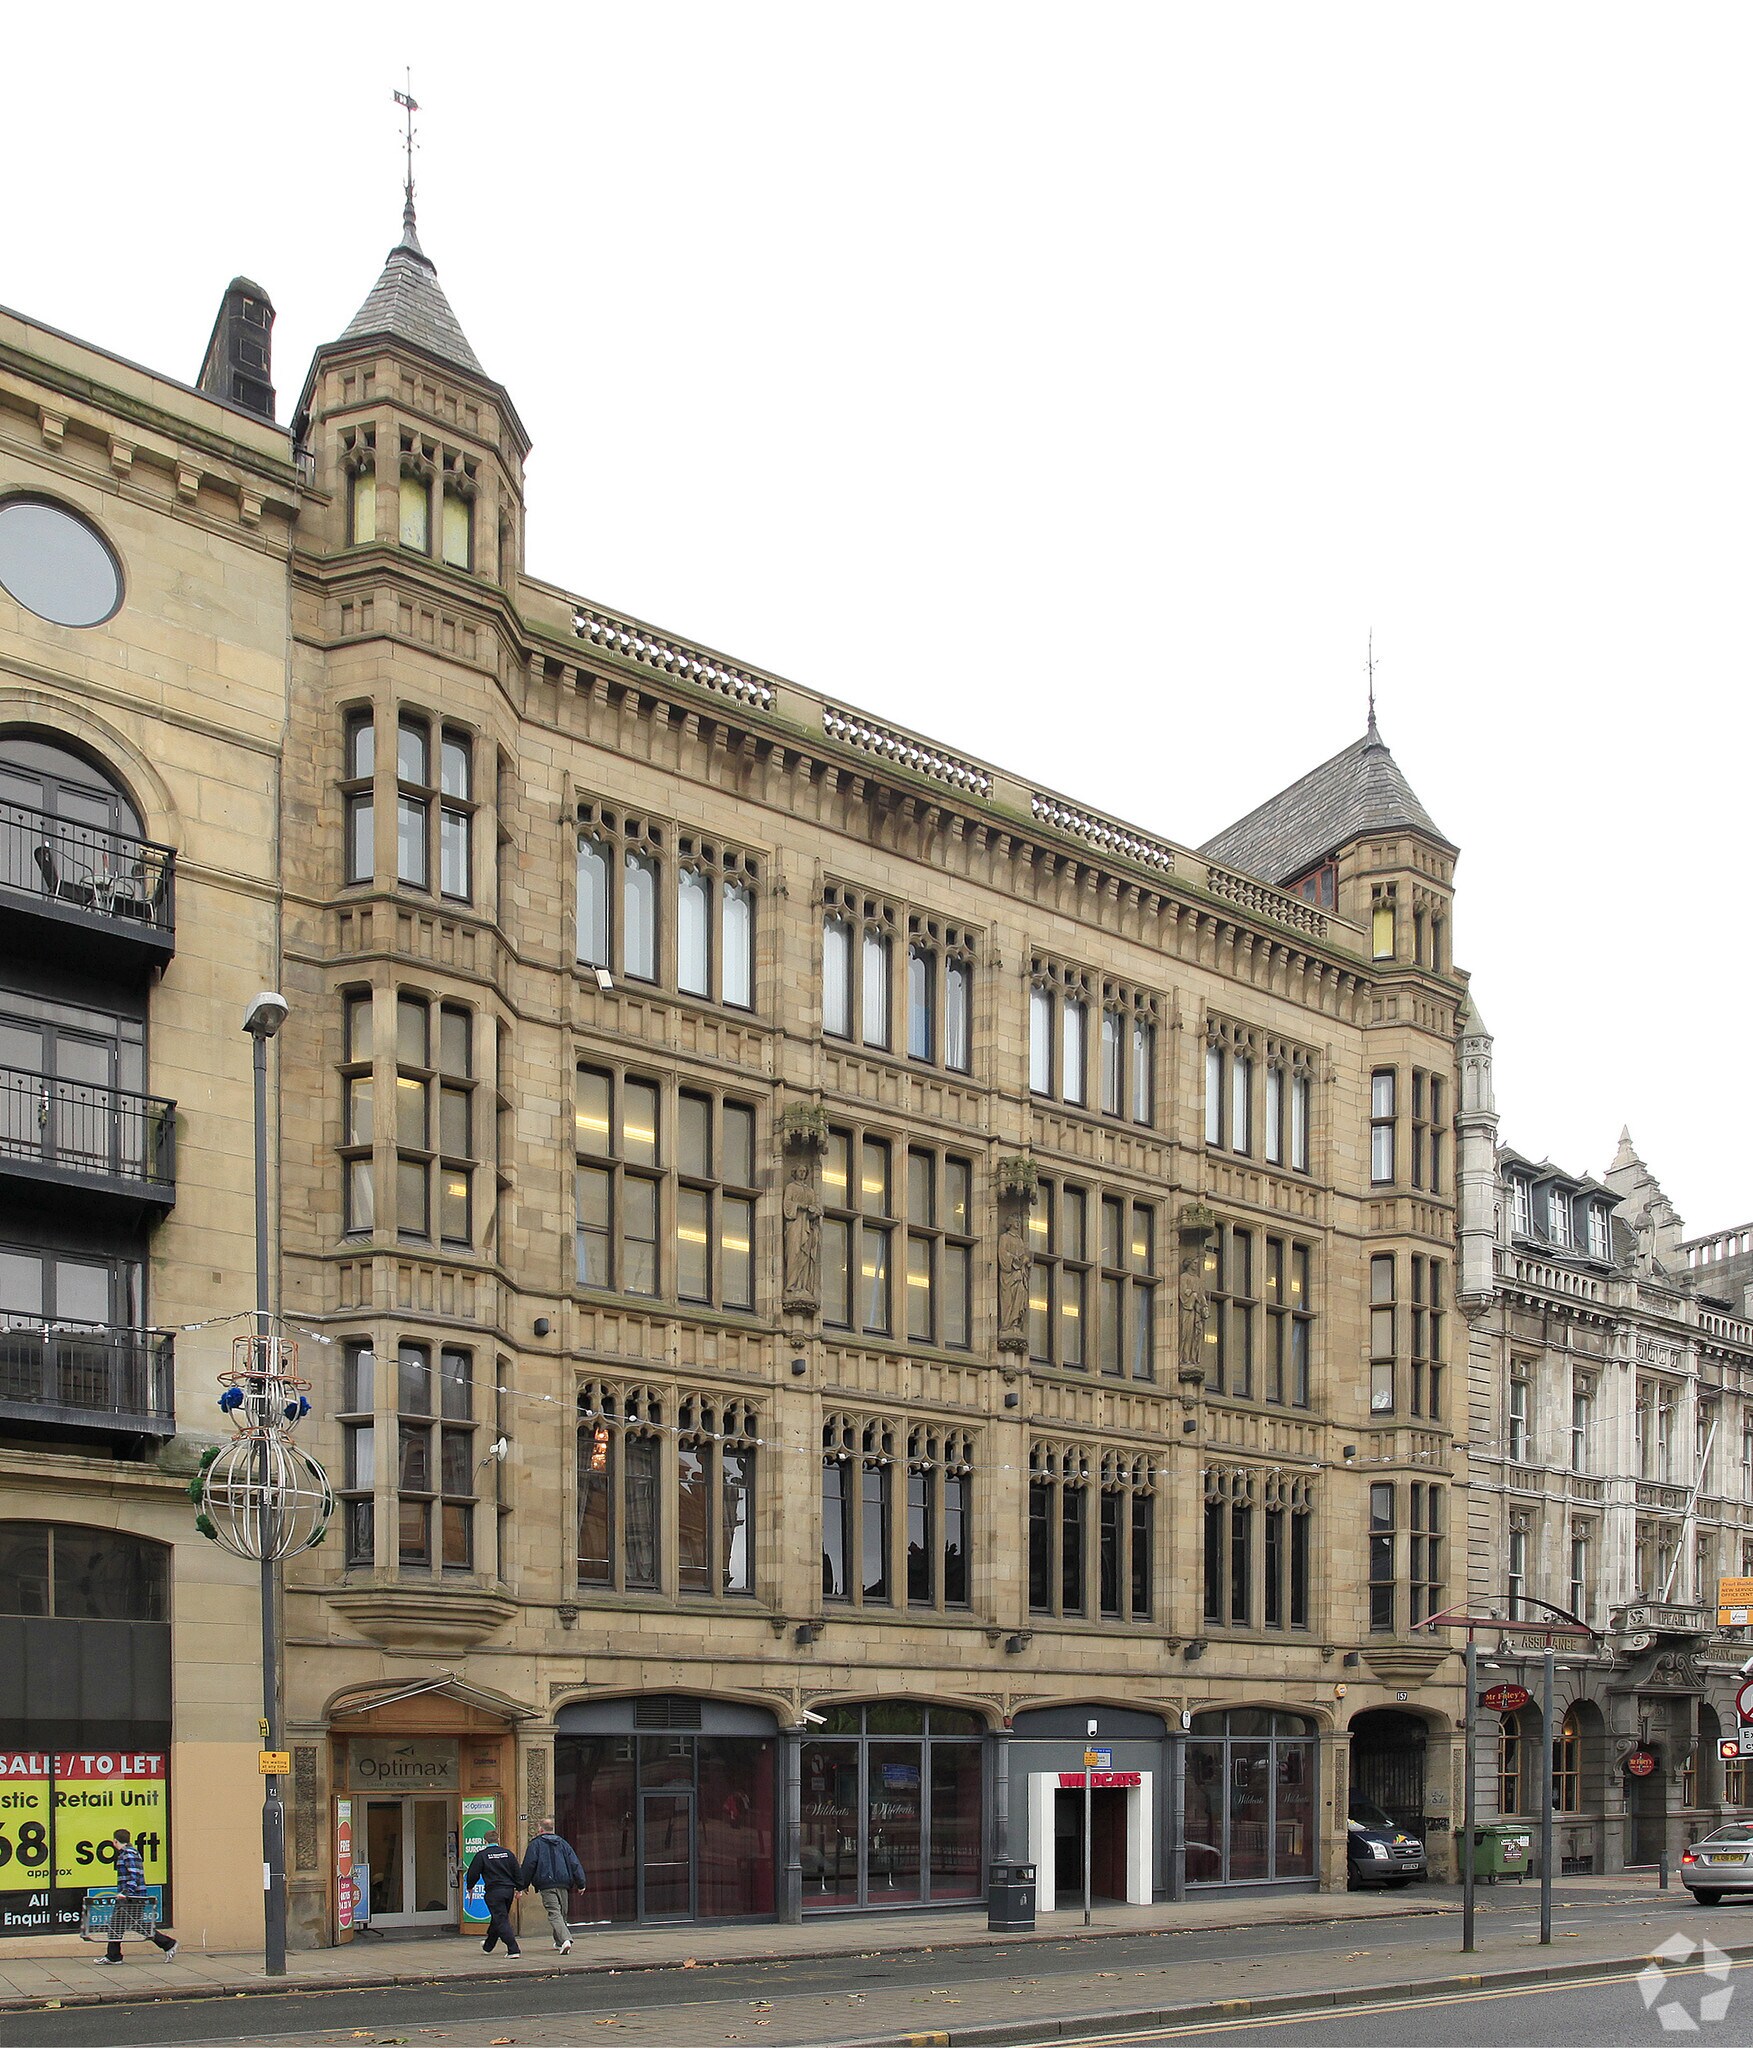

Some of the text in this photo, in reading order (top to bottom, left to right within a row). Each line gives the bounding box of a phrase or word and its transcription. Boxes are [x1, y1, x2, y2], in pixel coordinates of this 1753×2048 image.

[1521, 1636, 1577, 1651] ASSUANCE
[1397, 1692, 1408, 1701] 157
[1745, 1743, 1753, 1751] c
[80, 1755, 114, 1774] TO
[120, 1755, 161, 1774] LET
[359, 1758, 448, 1780] Optimax
[1058, 1771, 1142, 1787] WIDCATS
[1, 1790, 159, 1808] stic Retail Unit
[470, 1802, 493, 1812] Optimax
[806, 1802, 850, 1816] Wildcats
[135, 1832, 160, 1862] ft
[465, 1837, 482, 1845] LASER
[27, 1868, 72, 1878] approx
[29, 1894, 48, 1907] All
